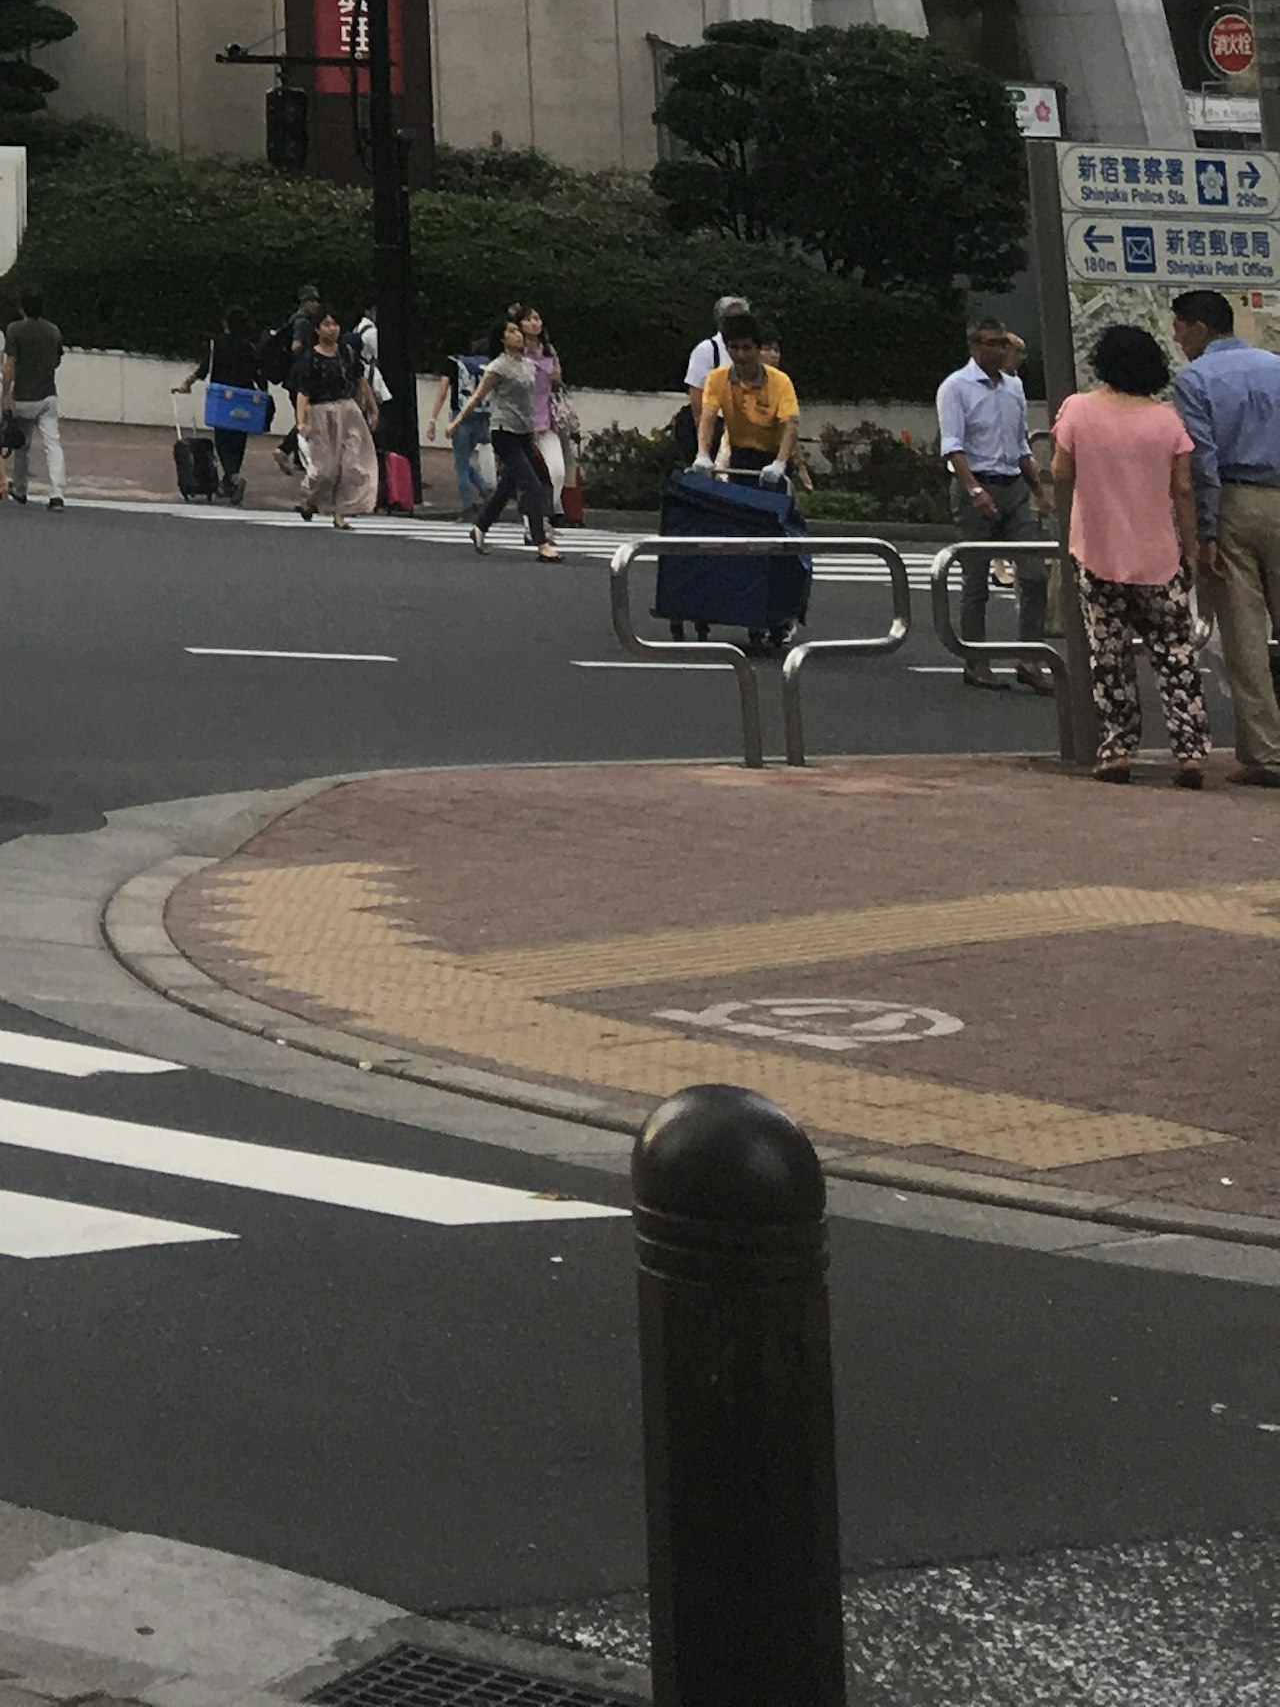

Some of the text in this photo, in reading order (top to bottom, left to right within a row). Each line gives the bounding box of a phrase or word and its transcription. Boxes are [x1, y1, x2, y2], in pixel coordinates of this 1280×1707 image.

[1213, 33, 1253, 56] 消火栓
[1078, 154, 1184, 186] 新宿警察署
[1081, 186, 1128, 204] Shinjuku
[1131, 188, 1165, 204] Police
[1236, 191, 1268, 208] 290m
[1166, 228, 1271, 259] 新宿郵便局
[1084, 257, 1118, 273] 180m
[1167, 259, 1274, 278] Shinjuku Post Office
